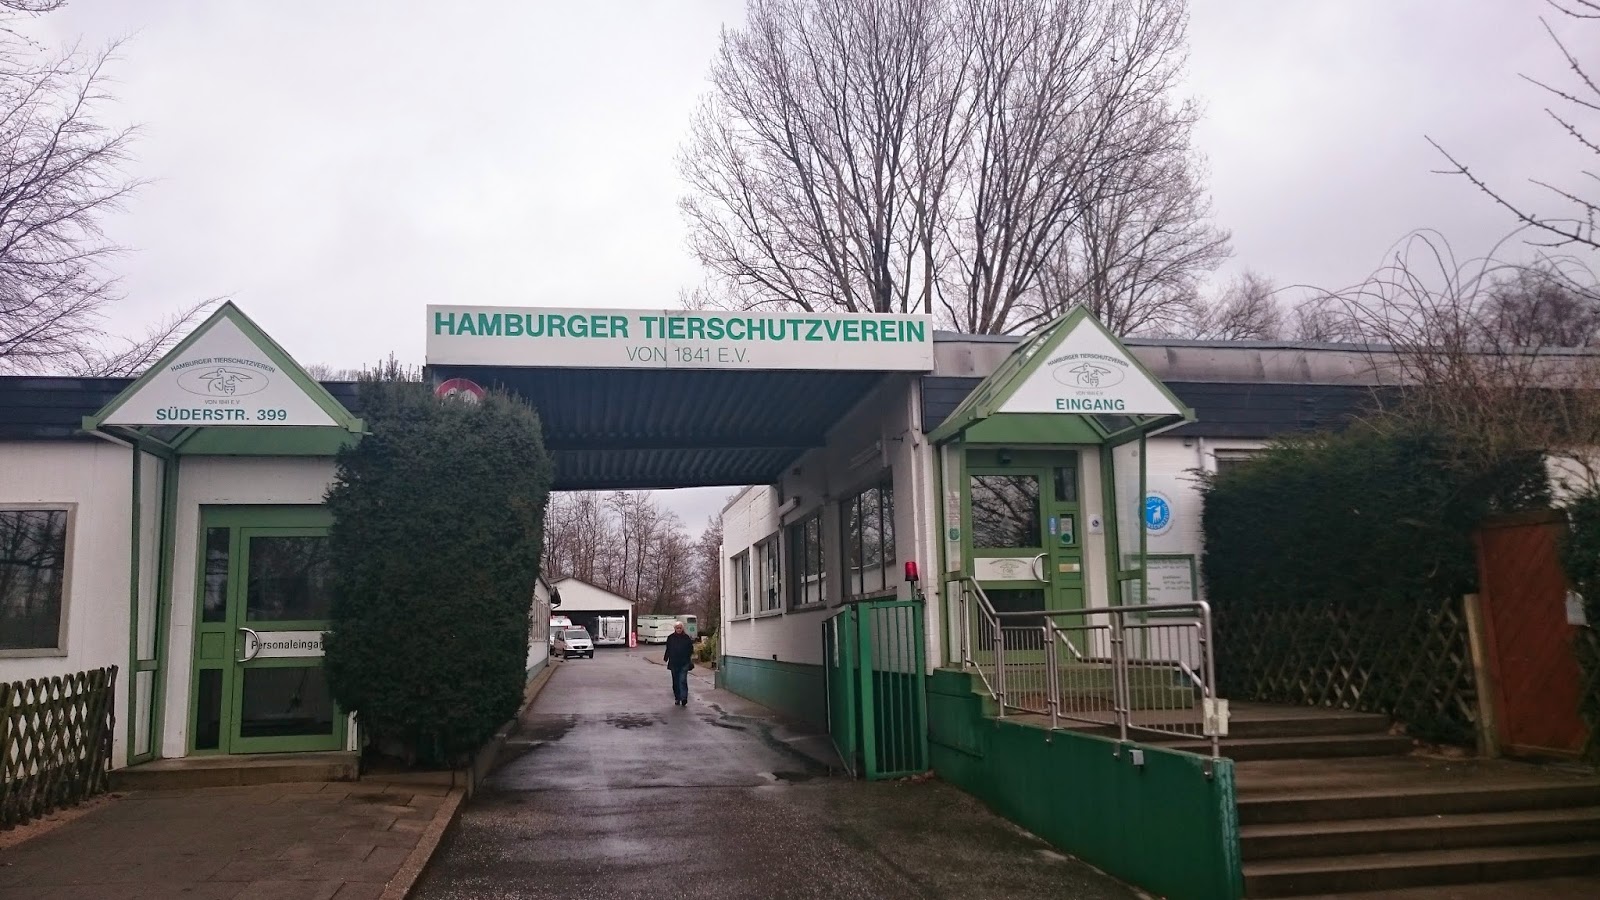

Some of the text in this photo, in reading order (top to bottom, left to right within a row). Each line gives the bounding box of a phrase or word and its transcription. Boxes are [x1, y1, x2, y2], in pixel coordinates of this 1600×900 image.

[435, 312, 925, 342] HAMBURGER TIERSCHUTZVEREIN
[626, 346, 750, 363] VON 1841 E.V.
[1048, 354, 1129, 367] HAMBURGER TIERSCHUTZVEREIN
[171, 358, 275, 373] HAMBURGER TIERSCHUTZVEREIN
[1055, 398, 1125, 411] EINGANG
[156, 406, 287, 422] SÜDERSTR. 399
[251, 640, 325, 650] Personaleingan
